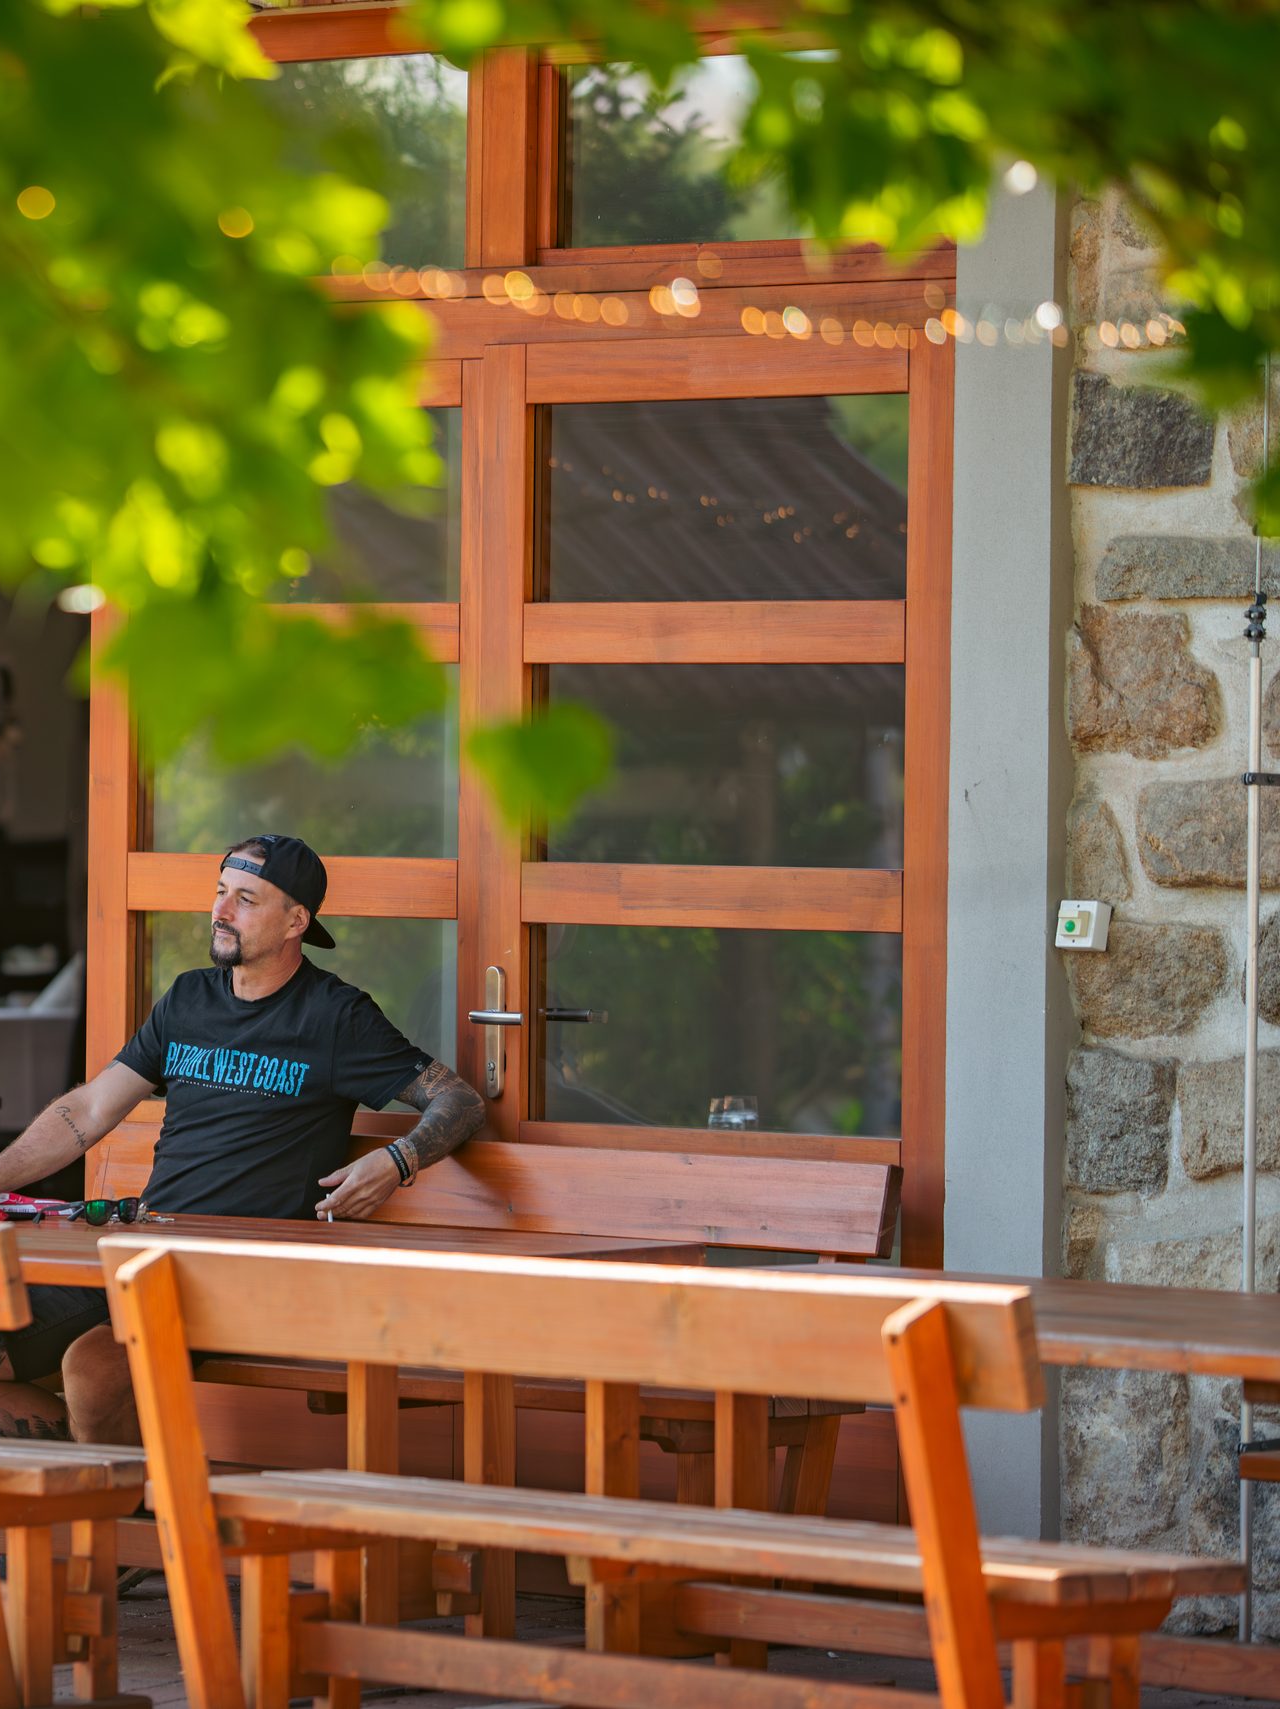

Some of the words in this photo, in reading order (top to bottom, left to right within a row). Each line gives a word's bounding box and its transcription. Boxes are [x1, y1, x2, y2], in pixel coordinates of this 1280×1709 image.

[164, 1041, 215, 1081] PITBULL
[213, 1047, 258, 1087] WEST
[253, 1055, 310, 1097] COAST
